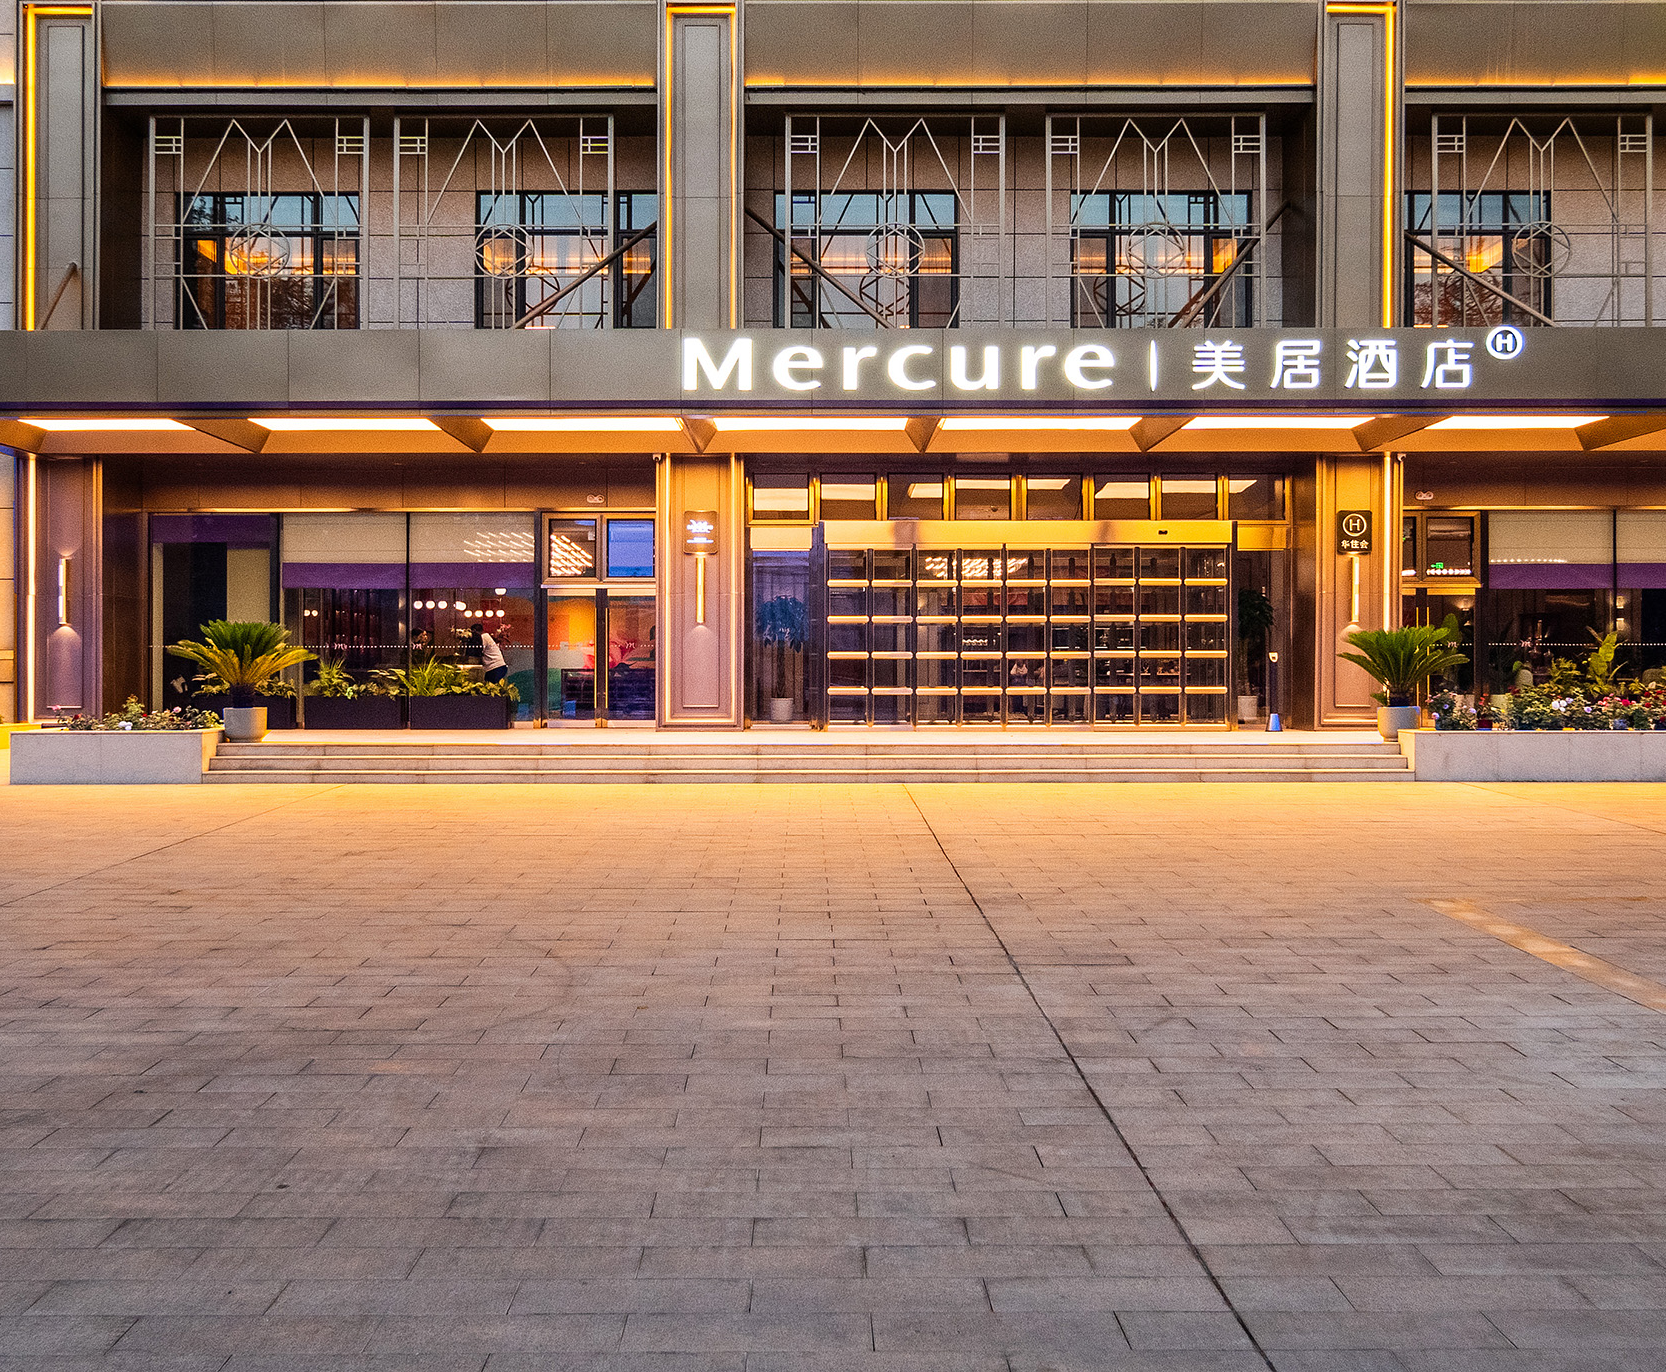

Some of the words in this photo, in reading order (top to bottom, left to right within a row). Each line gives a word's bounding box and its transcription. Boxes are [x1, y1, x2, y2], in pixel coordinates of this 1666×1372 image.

[682, 337, 1116, 392] Mercure
[1191, 338, 1475, 391] 美居酒店
[1341, 539, 1369, 549] 华住会
